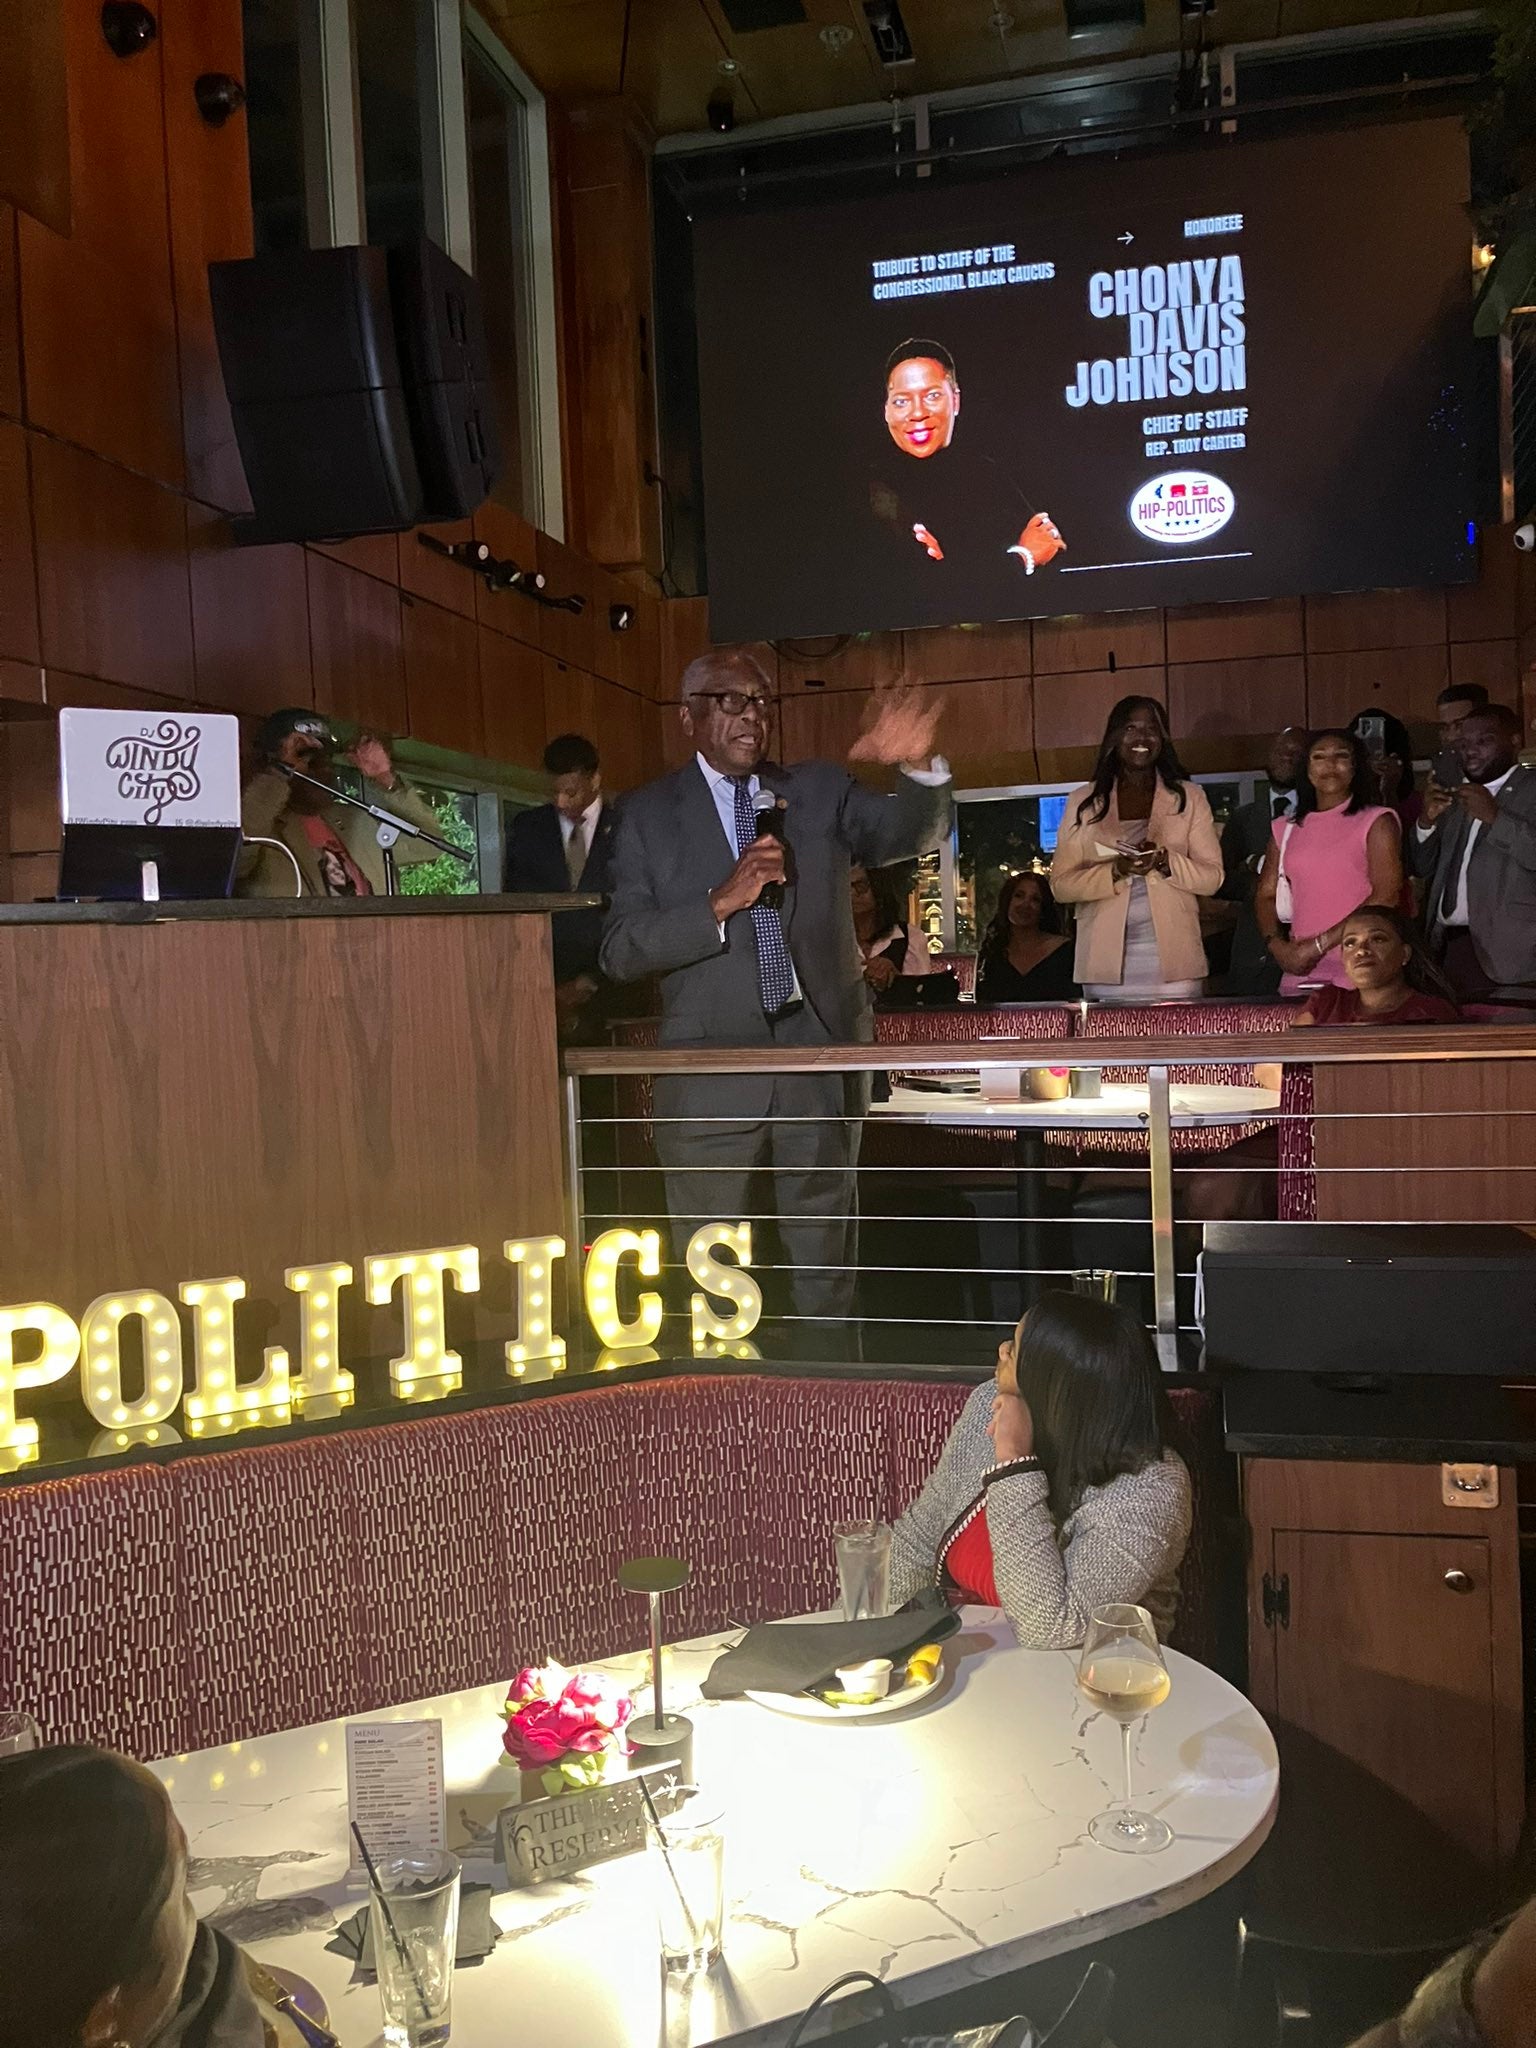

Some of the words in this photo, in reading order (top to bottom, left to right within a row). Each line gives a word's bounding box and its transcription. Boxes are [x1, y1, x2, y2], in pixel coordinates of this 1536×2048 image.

[873, 258, 919, 278] TRIBUTE
[920, 255, 936, 273] TO
[938, 250, 974, 269] STAFF
[975, 247, 991, 265] OF
[992, 244, 1015, 263] THE
[873, 274, 966, 300] CONGRESSIONAL
[967, 268, 1006, 288] BLACK
[1007, 262, 1055, 283] CAUCUS
[1089, 255, 1245, 318] CHONYA
[1130, 301, 1246, 357] DAVIS
[1065, 344, 1247, 408] JOHNSON
[1142, 415, 1183, 435] CHIEF
[1184, 412, 1204, 431] OF
[1205, 407, 1249, 429] STAFF
[1145, 441, 1172, 457] REP.
[1172, 437, 1201, 454] TROY
[1202, 433, 1246, 451] CARTER
[1138, 497, 1226, 520] HIP-POLITICS
[140, 727, 155, 738] DJ
[0, 1222, 763, 1449] POLITICS
